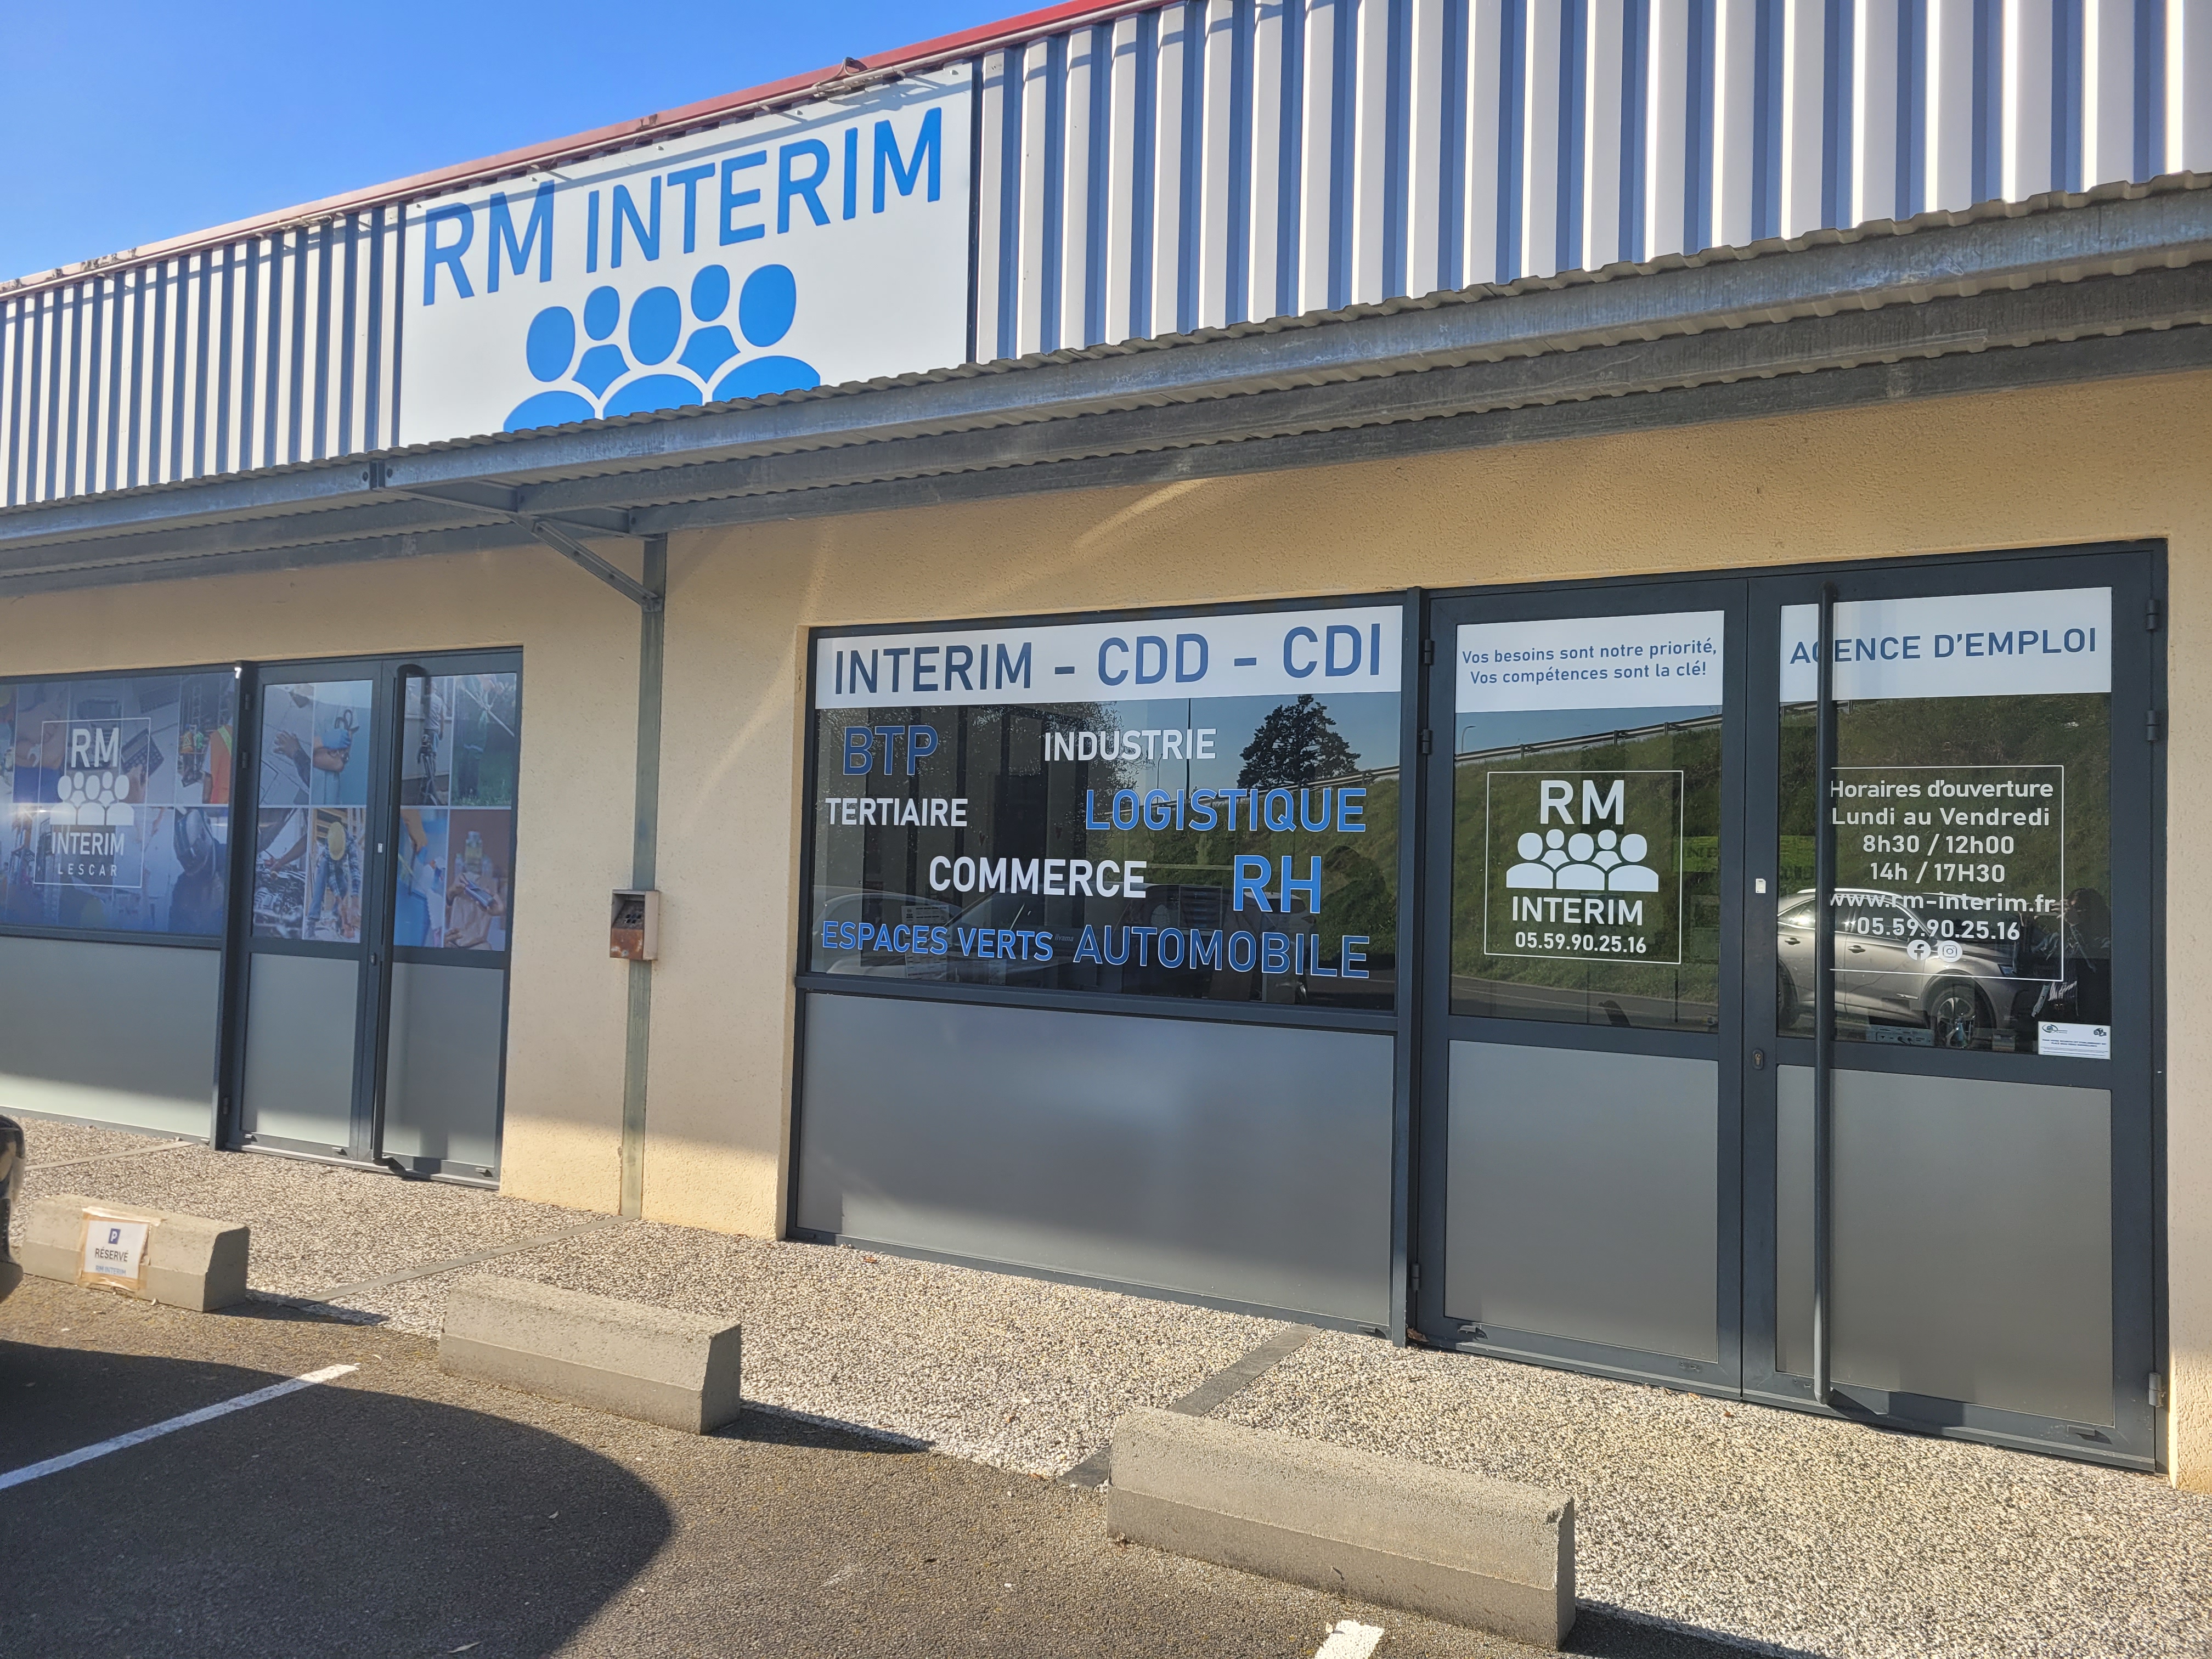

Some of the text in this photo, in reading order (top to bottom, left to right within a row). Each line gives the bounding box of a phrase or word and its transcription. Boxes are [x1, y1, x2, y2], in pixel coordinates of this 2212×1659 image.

[424, 107, 941, 306] RM INTERIM
[1462, 637, 1717, 664] Vos besoins sont notre priorité,
[1934, 628, 2096, 658] D'EMPLOI
[835, 642, 1032, 695] INTERIM
[1098, 633, 1208, 686] CDD
[1283, 623, 1380, 678] CDI
[1470, 660, 1707, 685] Vos compétences sont la clé!
[71, 727, 119, 768] RM
[842, 724, 939, 776] BTP
[1045, 728, 1217, 762] INDUSTRIE
[1540, 780, 1624, 825] RM
[1831, 780, 2053, 797] Horaires d'ouverture
[826, 798, 968, 827] TERTIAIRE
[1085, 788, 1367, 833] LOGISTIQUE
[1832, 808, 2050, 826] Lundi au Vendredi
[52, 832, 125, 856] INTERIM
[1863, 833, 2014, 856] 8h30 / 12h00
[58, 863, 117, 877] LESCAR
[929, 855, 1147, 899] COMMERCE
[1233, 854, 1322, 915] RH
[1870, 861, 2005, 884] 14h / 17H30
[1512, 896, 1643, 926] INTERIM
[822, 921, 1053, 961] ESPACES VERTS
[1515, 932, 1647, 953] 05.59.90.25.16
[1857, 917, 2020, 940] 05.59.90.25.16
[1073, 924, 1370, 979] AUTOMOBILE
[95, 1246, 128, 1262] RÉSERVÉ
[104, 1266, 126, 1276] INTERIM
